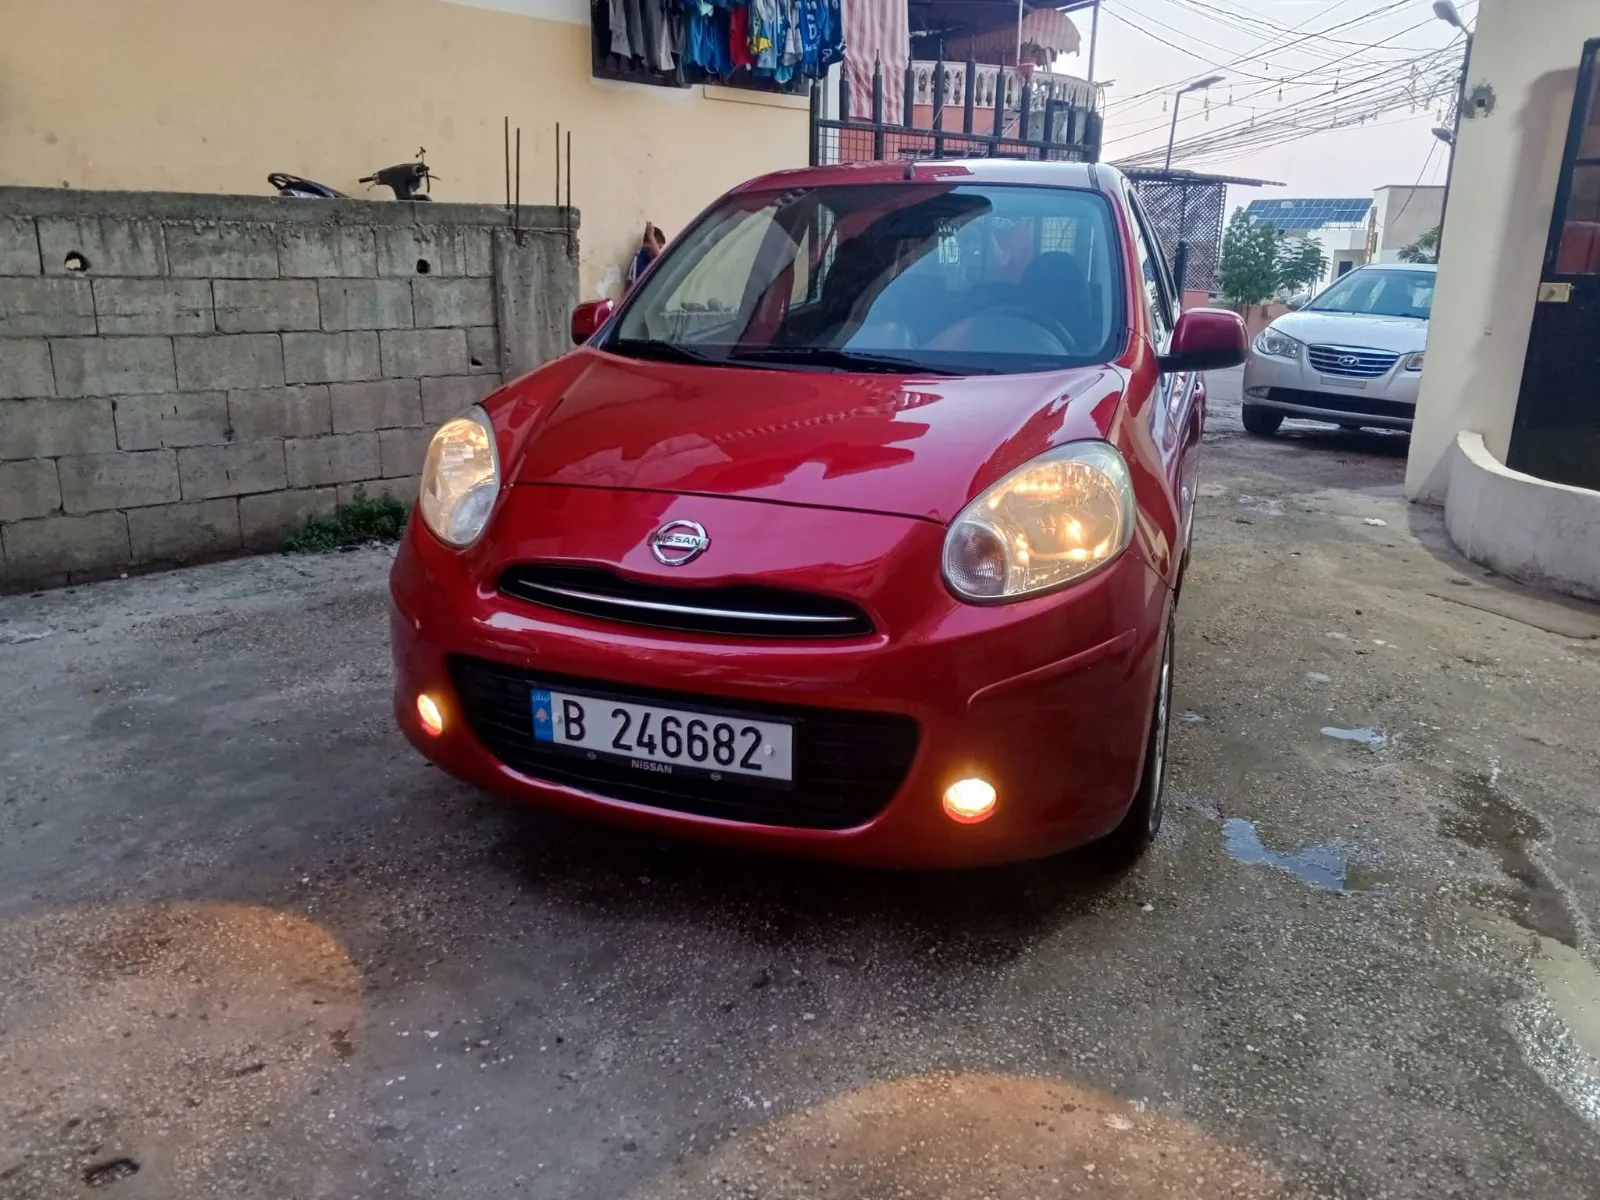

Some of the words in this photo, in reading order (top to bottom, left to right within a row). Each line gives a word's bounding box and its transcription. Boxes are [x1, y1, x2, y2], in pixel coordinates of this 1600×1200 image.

[653, 534, 702, 546] NISSAN
[562, 698, 586, 742] B
[610, 707, 763, 771] 246682
[631, 759, 673, 774] NISSAN
